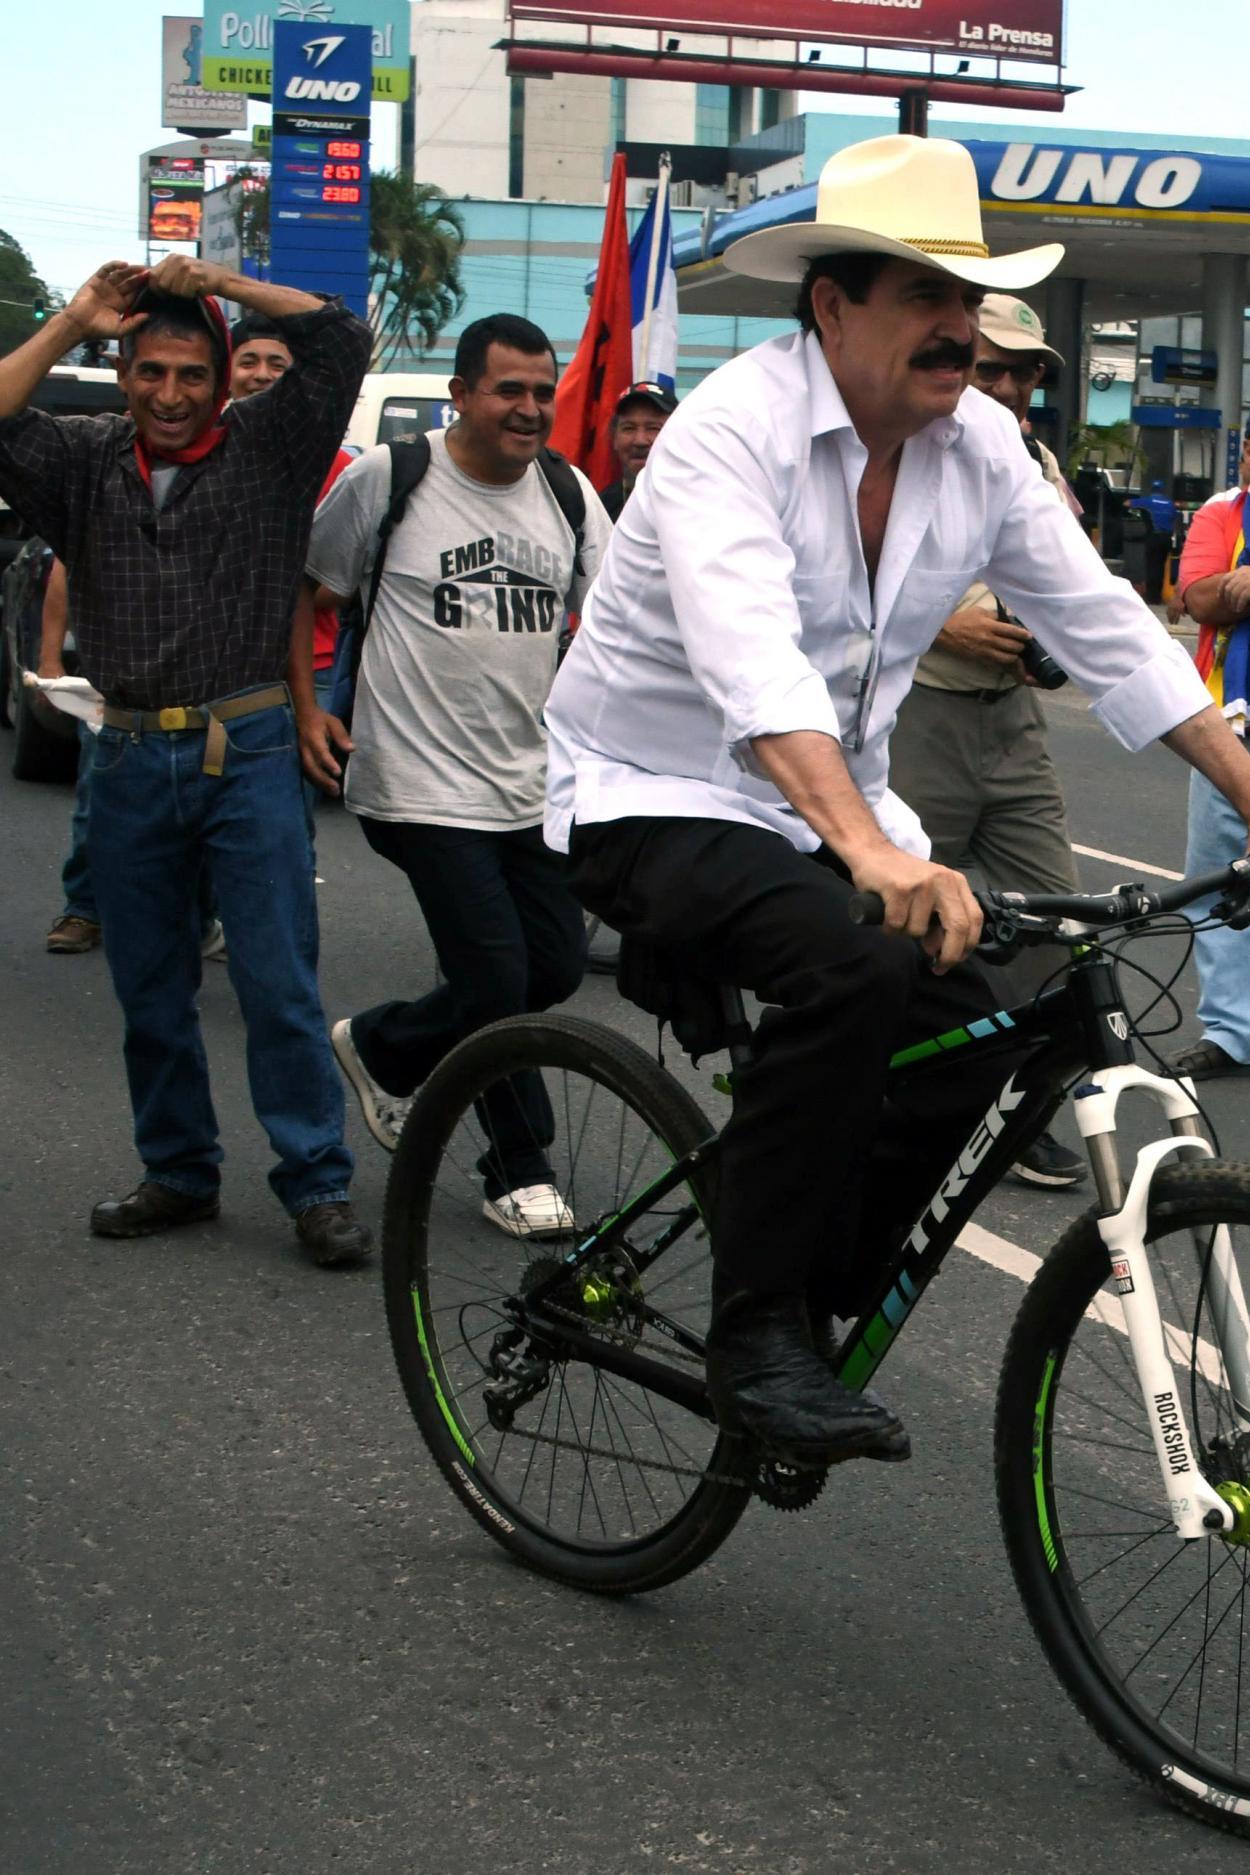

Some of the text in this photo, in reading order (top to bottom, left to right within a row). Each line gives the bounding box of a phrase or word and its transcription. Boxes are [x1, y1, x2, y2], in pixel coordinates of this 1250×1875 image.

[220, 12, 273, 50] Poll
[959, 20, 1054, 47] La Prensa
[218, 66, 272, 86] CHICKE
[285, 76, 361, 102] UNO
[990, 142, 1203, 209] UNO
[440, 531, 563, 585] EMBRACE
[490, 570, 509, 583] THE
[433, 583, 558, 633] GRIND
[901, 1070, 1028, 1255] TREK
[1153, 1391, 1191, 1475] ROCKSHOX
